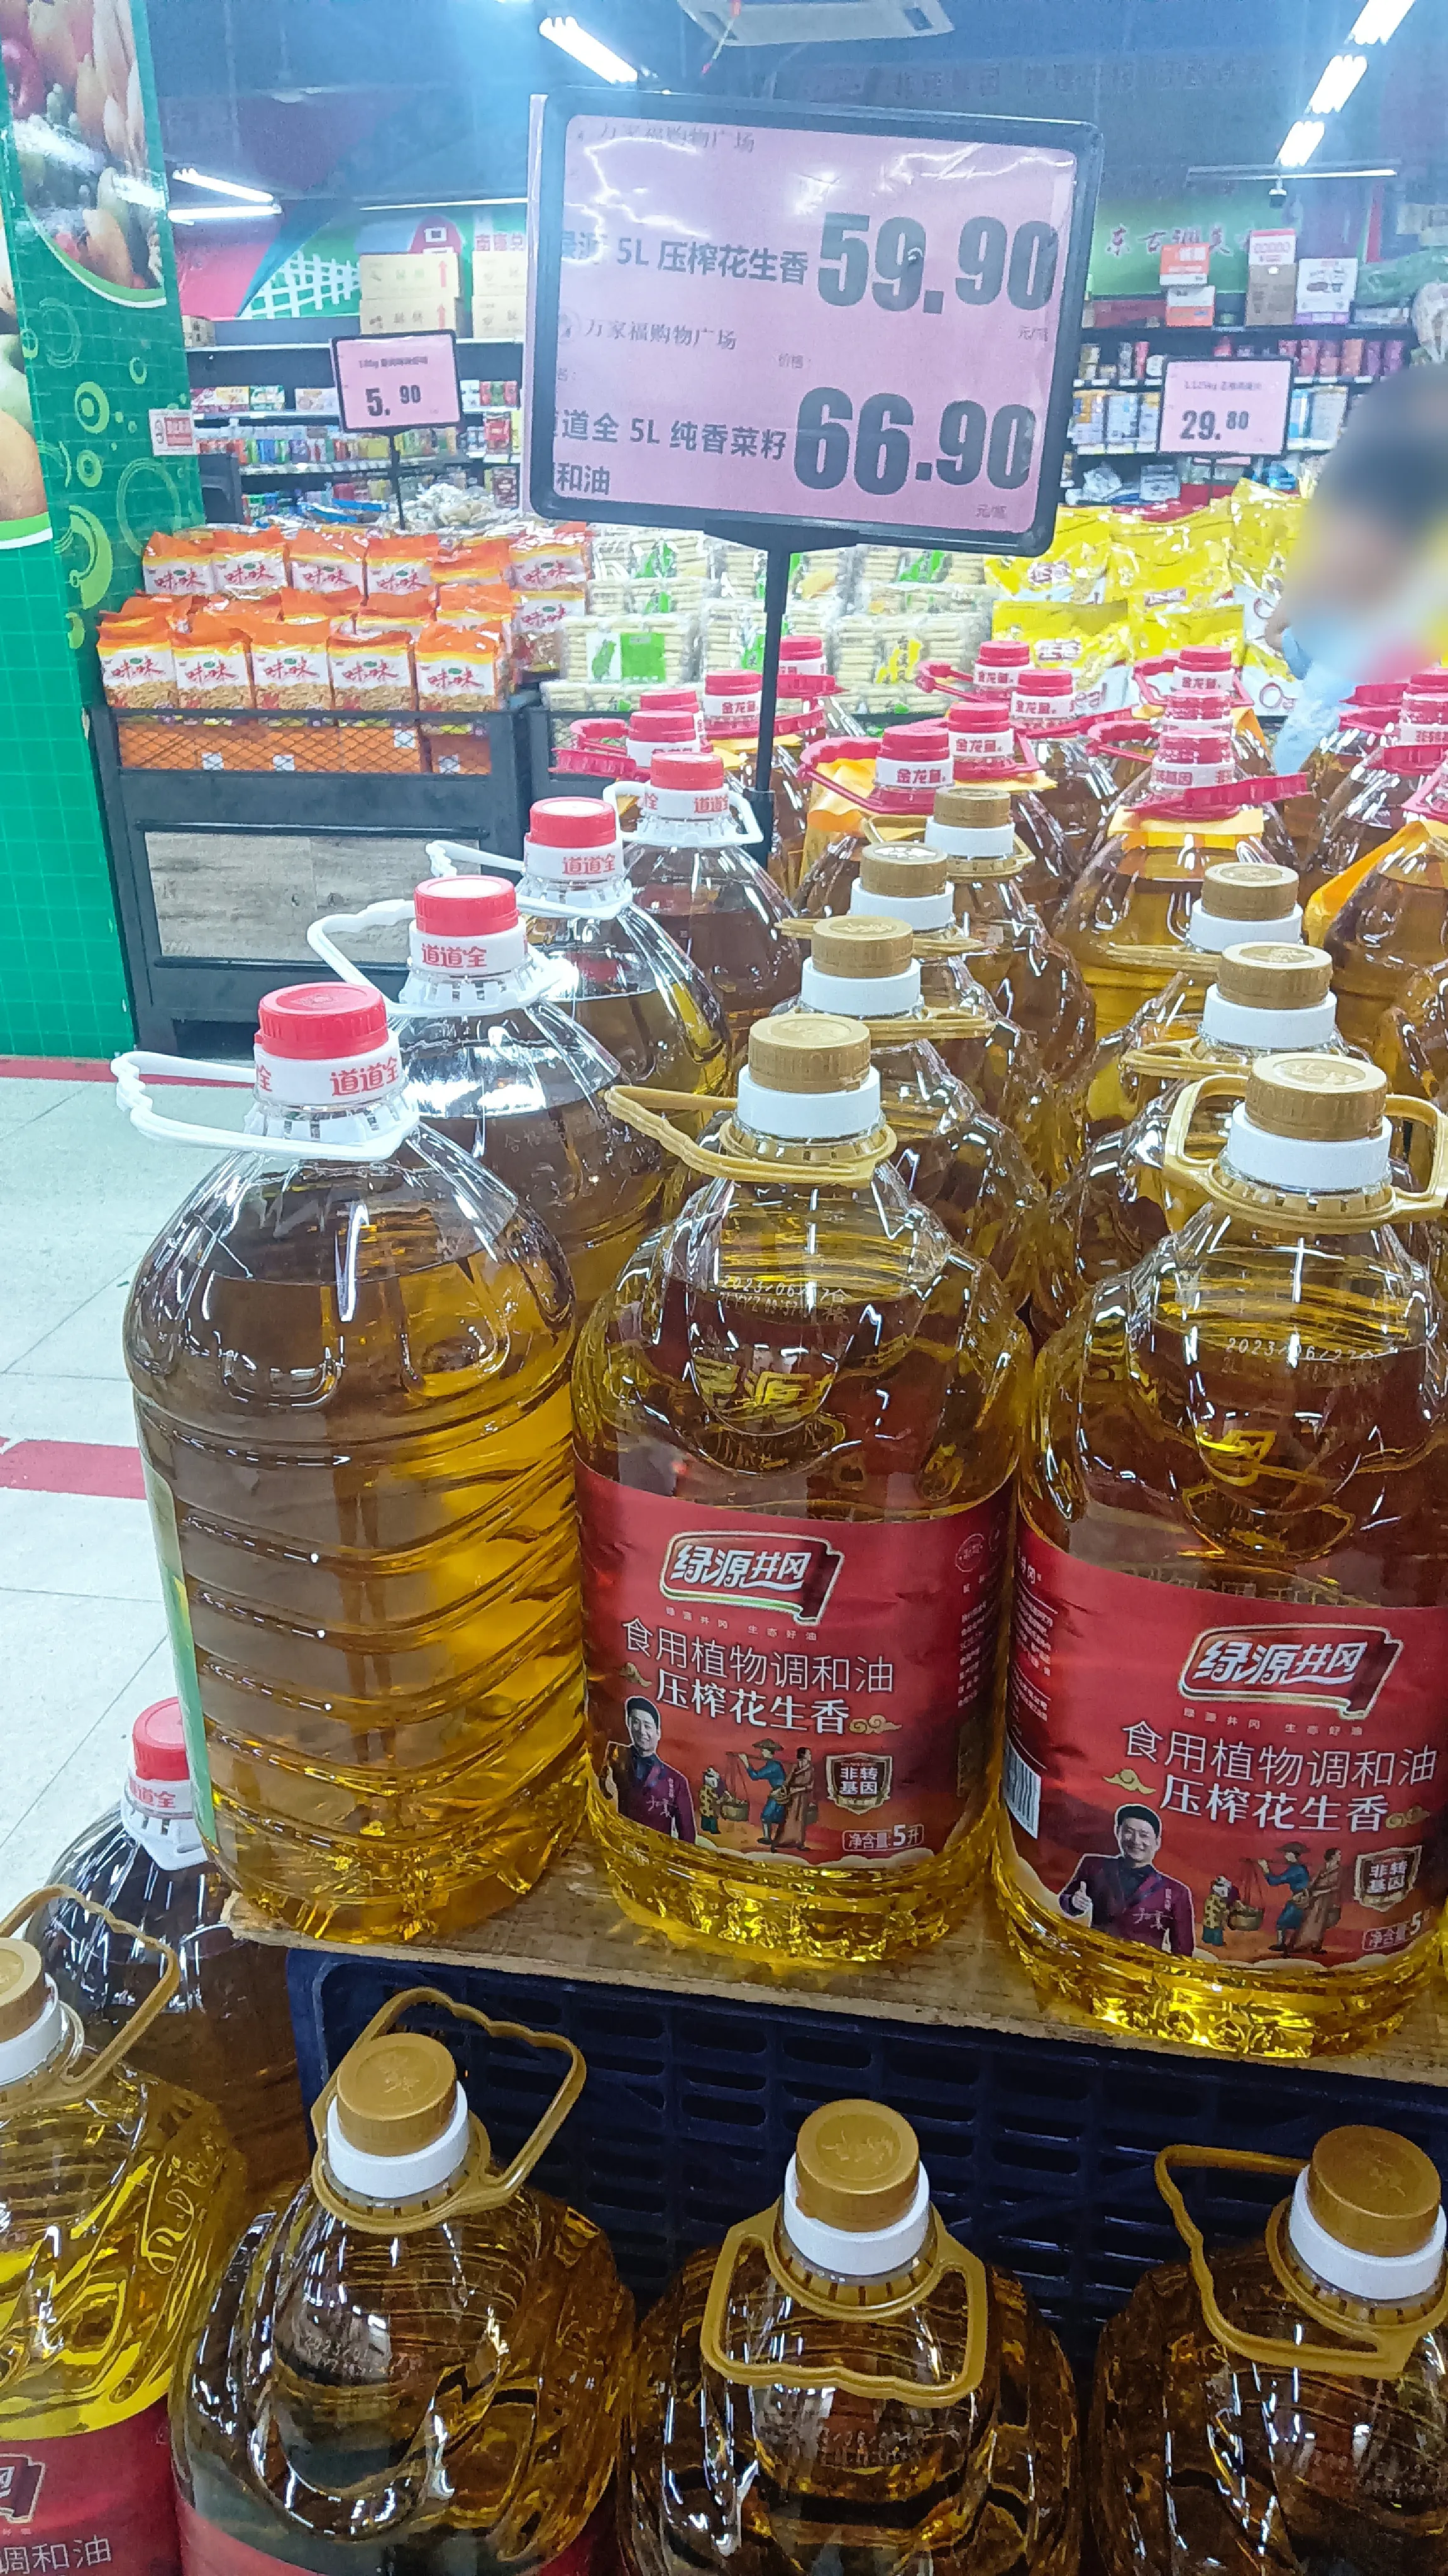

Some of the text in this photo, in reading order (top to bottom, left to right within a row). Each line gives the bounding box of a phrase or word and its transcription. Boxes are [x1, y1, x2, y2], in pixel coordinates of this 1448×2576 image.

[617, 237, 649, 265] 5L
[658, 240, 809, 285] 压榨花生香
[817, 212, 1059, 314] 59.90
[585, 318, 738, 350] 万家福购物广场
[365, 384, 421, 416] 5.90
[555, 409, 787, 460] 道全 5L 纯香菜籽
[793, 387, 1037, 496] 66.90
[1179, 409, 1250, 441] 29.80
[555, 462, 611, 496] 和油
[562, 852, 616, 876] 道道全
[421, 943, 488, 969] 道道全
[330, 1055, 399, 1097] 道道全
[670, 1545, 812, 1591] 绿源井冈
[622, 1617, 894, 1694] 食用植物调和油
[1193, 1640, 1368, 1685] 绿源井冈
[656, 1668, 851, 1736] 压榨花生香
[839, 1766, 879, 1780] 非转
[1122, 1720, 1439, 1789] 食用植物调和油
[839, 1780, 878, 1795] 基因
[1160, 1773, 1390, 1833] 压榨花生香
